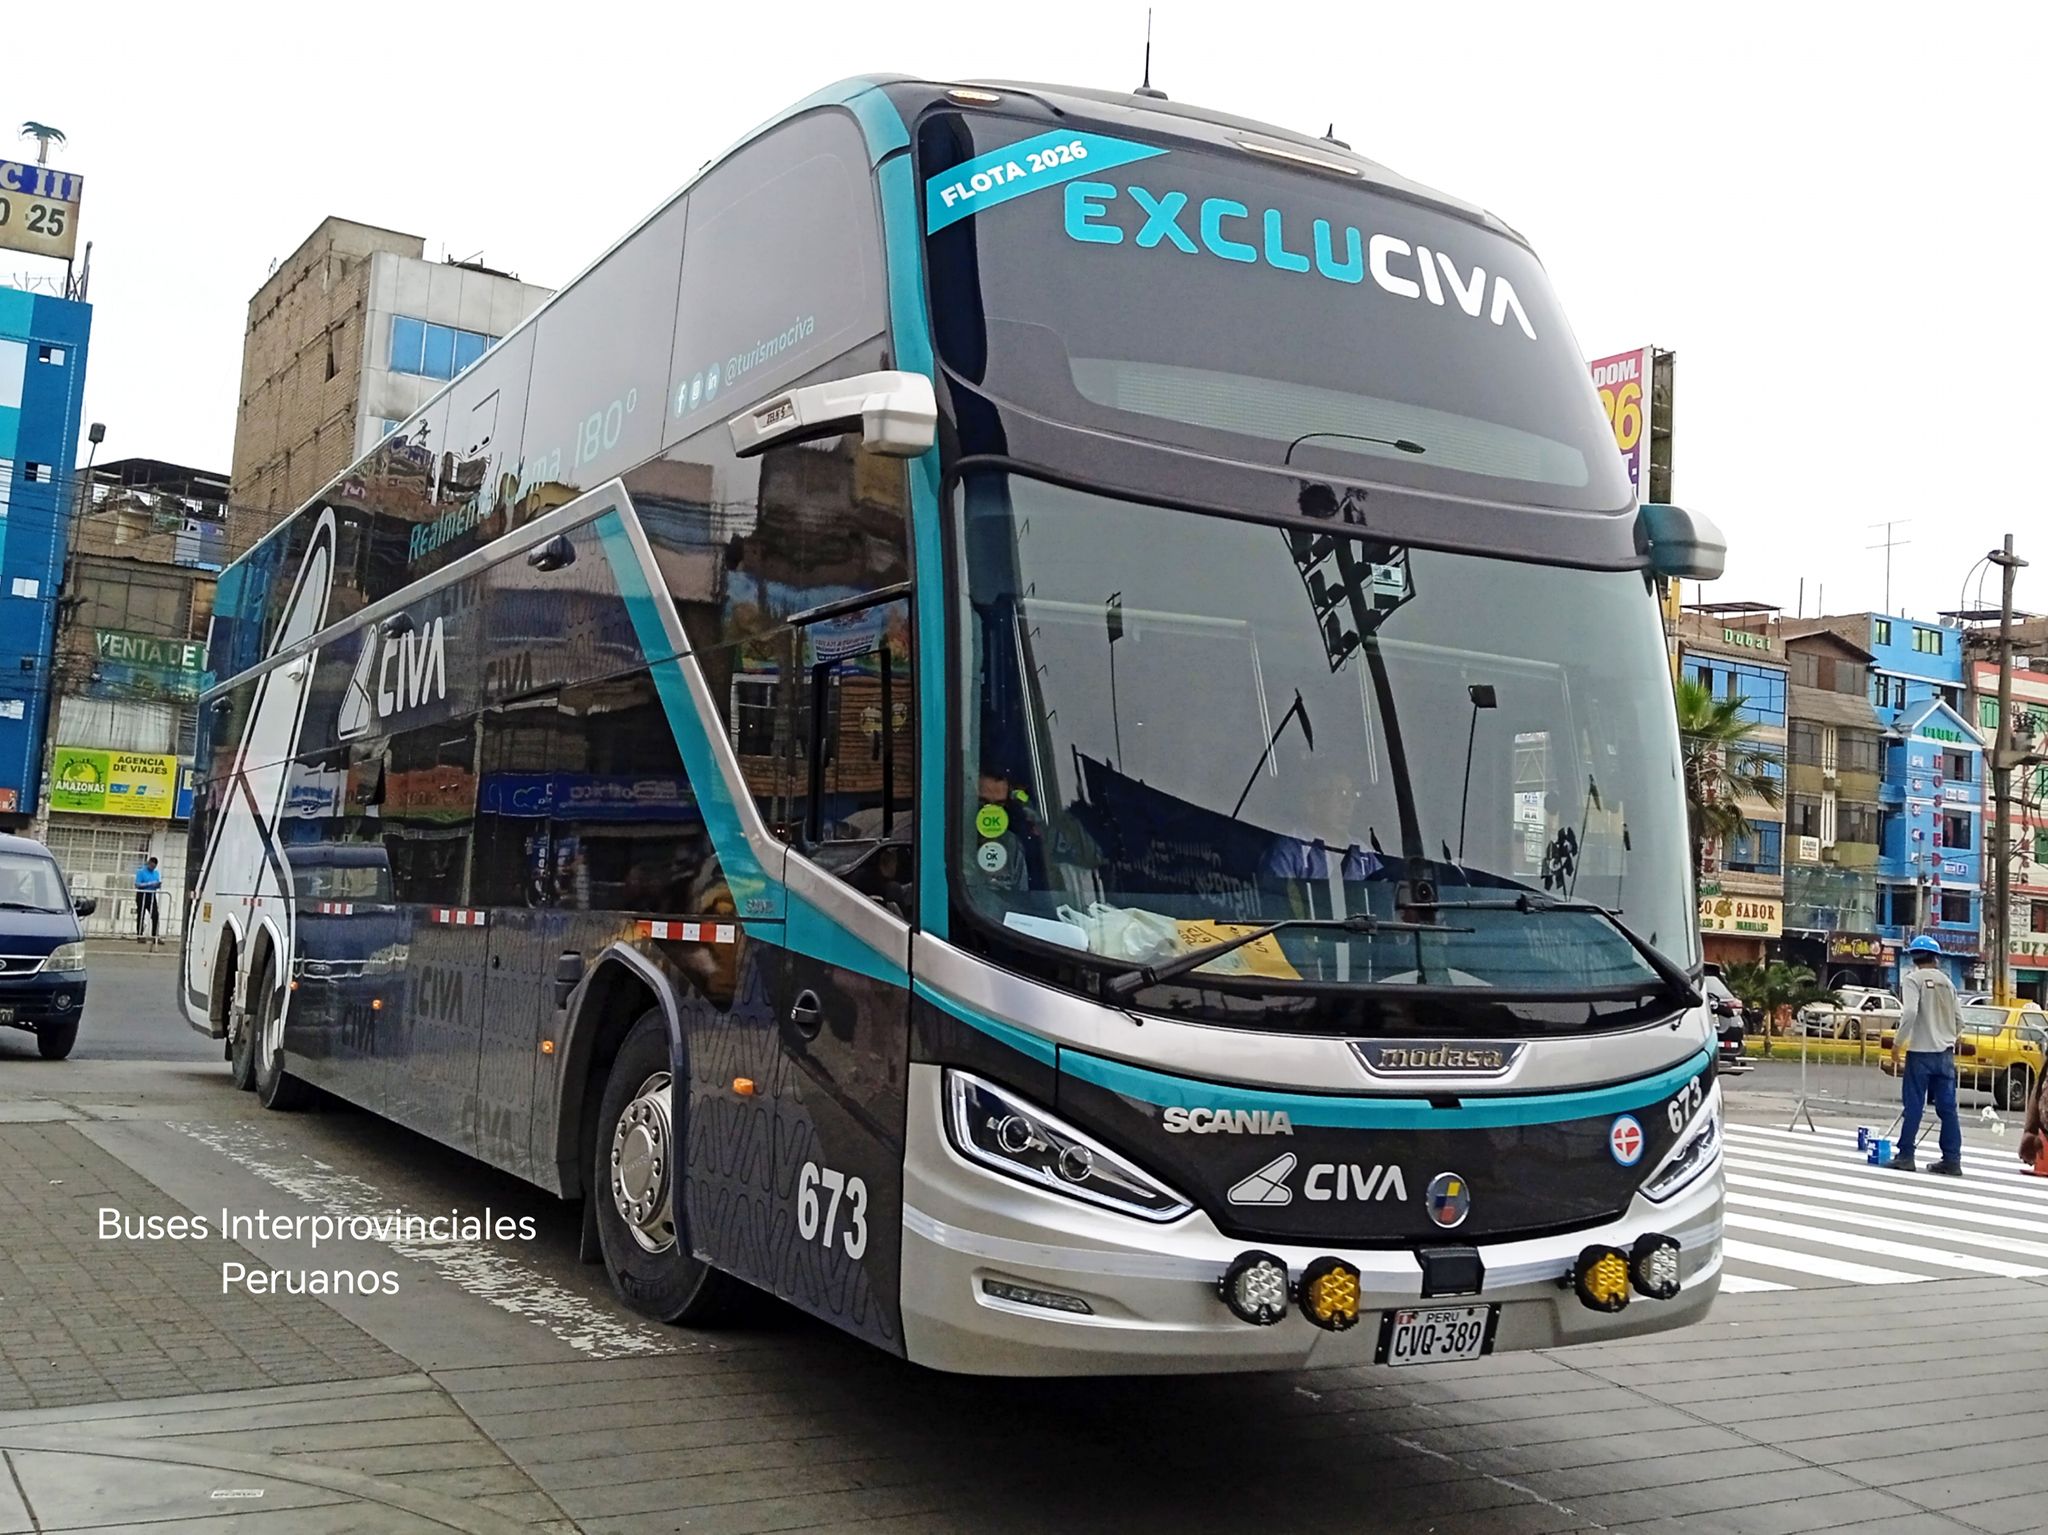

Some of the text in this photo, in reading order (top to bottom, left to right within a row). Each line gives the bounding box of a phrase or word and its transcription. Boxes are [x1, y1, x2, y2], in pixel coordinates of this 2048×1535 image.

[33, 168, 82, 202] III
[940, 140, 1088, 208] FLOTA 2026
[27, 204, 66, 237] 25
[1064, 181, 1537, 340] EXCLUCIVA
[724, 315, 815, 387] @turismociva
[1593, 358, 1639, 388] DOM.
[407, 488, 493, 565] Realmen
[96, 632, 196, 667] VENTA DE
[1724, 628, 1771, 651] Dubai
[377, 616, 446, 718] CIVA
[112, 763, 168, 775] DE VIAJES
[117, 756, 165, 767] AGENCIA
[55, 780, 105, 794] AMAZONAS
[982, 816, 1001, 827] OK
[986, 852, 998, 860] OK
[1931, 754, 1943, 927] HOSPEDAJE
[1736, 902, 1775, 920] SABOR
[1376, 1043, 1502, 1069] modasa
[1667, 1075, 1703, 1134] 673
[1162, 1106, 1295, 1137] SCANIA
[1303, 1163, 1409, 1203] CIVA
[797, 1161, 868, 1261] 673
[1425, 1311, 1461, 1324] PERU
[1394, 1320, 1482, 1358] CVQ-389
